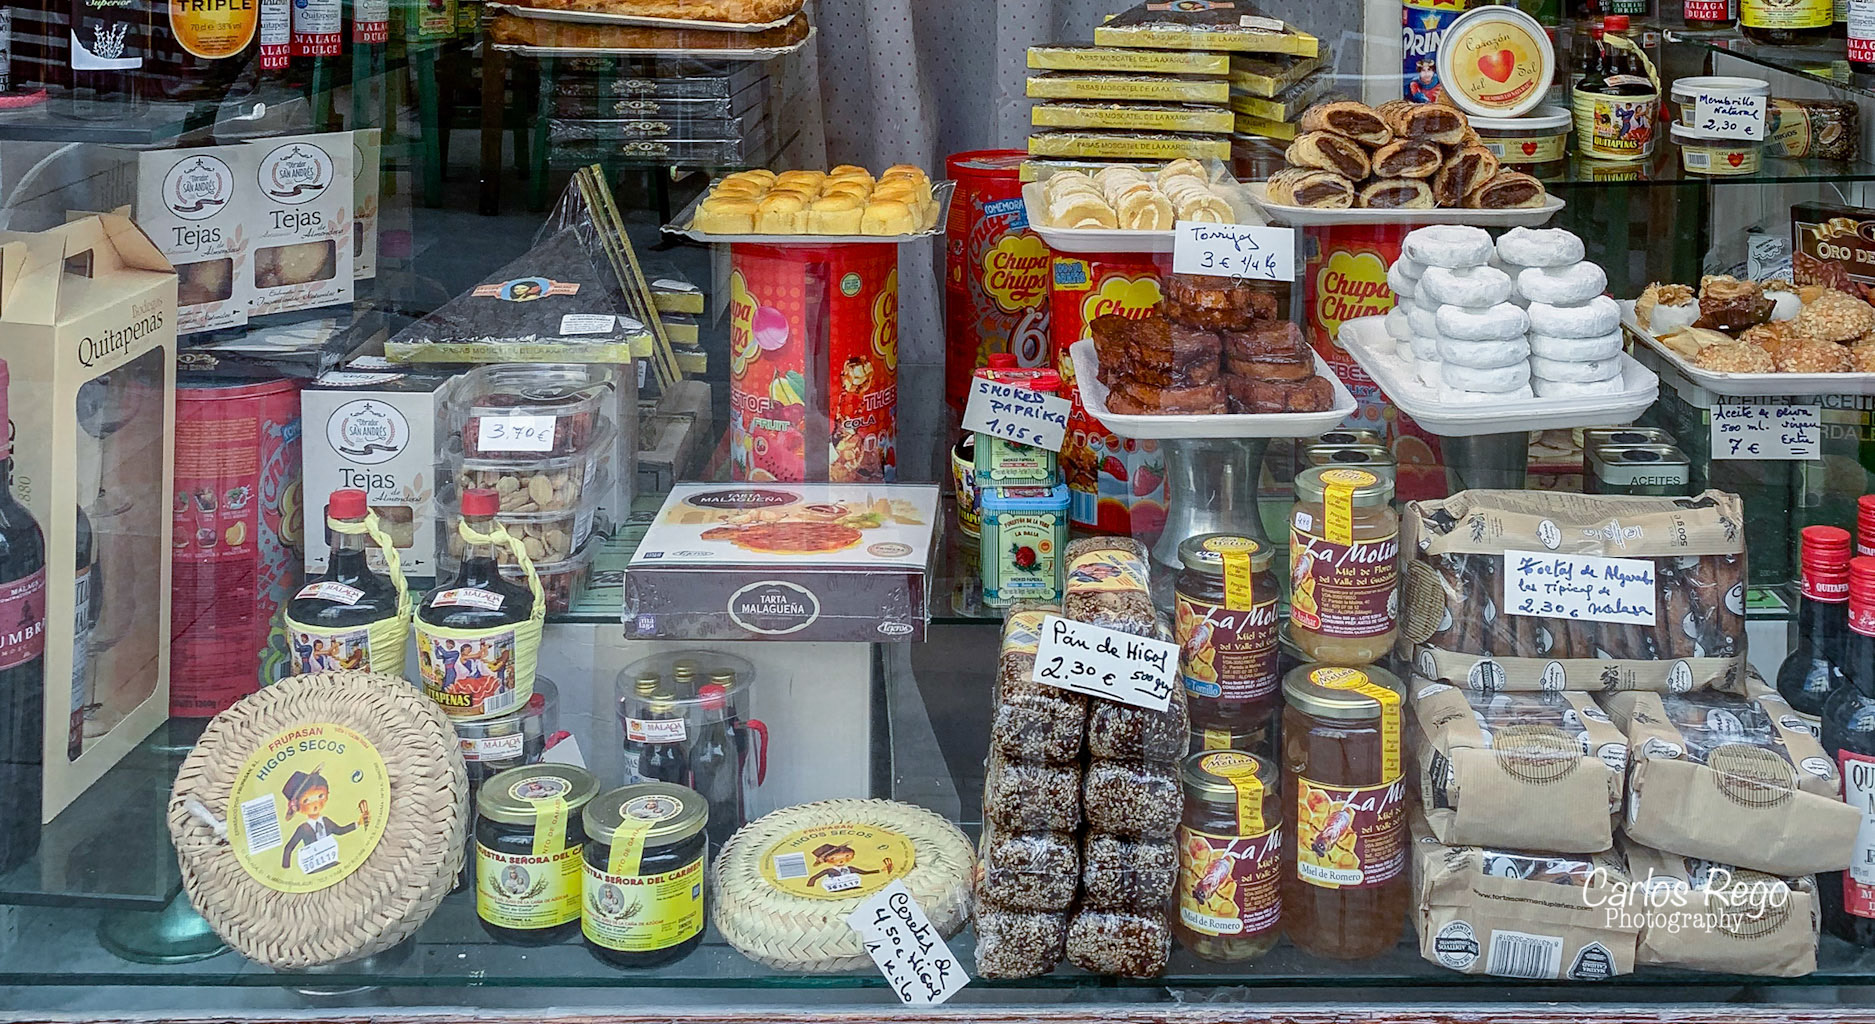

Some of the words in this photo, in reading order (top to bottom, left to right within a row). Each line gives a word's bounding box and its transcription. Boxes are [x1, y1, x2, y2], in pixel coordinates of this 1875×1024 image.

[1684, 0, 1724, 11] MALAGA
[1688, 9, 1719, 19] DULCE
[302, 43, 338, 55] DULCE
[1466, 32, 1511, 51] Corazón
[1516, 61, 1537, 77] Sol
[1700, 94, 1755, 108] Membrillo
[270, 208, 321, 234] Tejas
[172, 225, 220, 251] Tejas
[1201, 251, 1214, 268] 3
[1219, 257, 1230, 268] €
[1817, 241, 1852, 261] ORO
[993, 251, 1048, 276] Chupa
[1324, 271, 1390, 305] Chupa
[131, 296, 163, 319] Bodegas
[78, 308, 163, 367] Quitapenas
[844, 414, 876, 429] COLA
[989, 399, 1067, 430] PAPRIKA
[753, 417, 791, 432] FRUIT
[1728, 438, 1743, 455] 7
[338, 467, 395, 496] Tejas
[1630, 476, 1681, 486] ACEITES
[1335, 565, 1357, 576] Miel
[1334, 576, 1353, 586] Valle
[759, 594, 788, 605] TARTA
[741, 602, 805, 615] MALAGUEÑA
[1201, 605, 1235, 630] La
[1192, 681, 1219, 695] Tomillo
[268, 726, 325, 752] FRUPASAN
[256, 745, 297, 782] HIGOS
[299, 738, 347, 756] SECOS
[1341, 788, 1376, 812] La
[790, 829, 827, 848] HIGOS
[830, 829, 874, 840] SECOS
[508, 855, 550, 865] SEÑORA
[552, 851, 568, 862] DEL
[1221, 838, 1257, 861] La
[604, 874, 645, 886] SEÑORA
[646, 875, 665, 885] DEL
[1301, 862, 1320, 879] Miel
[1320, 868, 1329, 880] de
[1329, 869, 1361, 882] Romero
[1199, 914, 1208, 925] de
[1207, 916, 1241, 931] Romero
